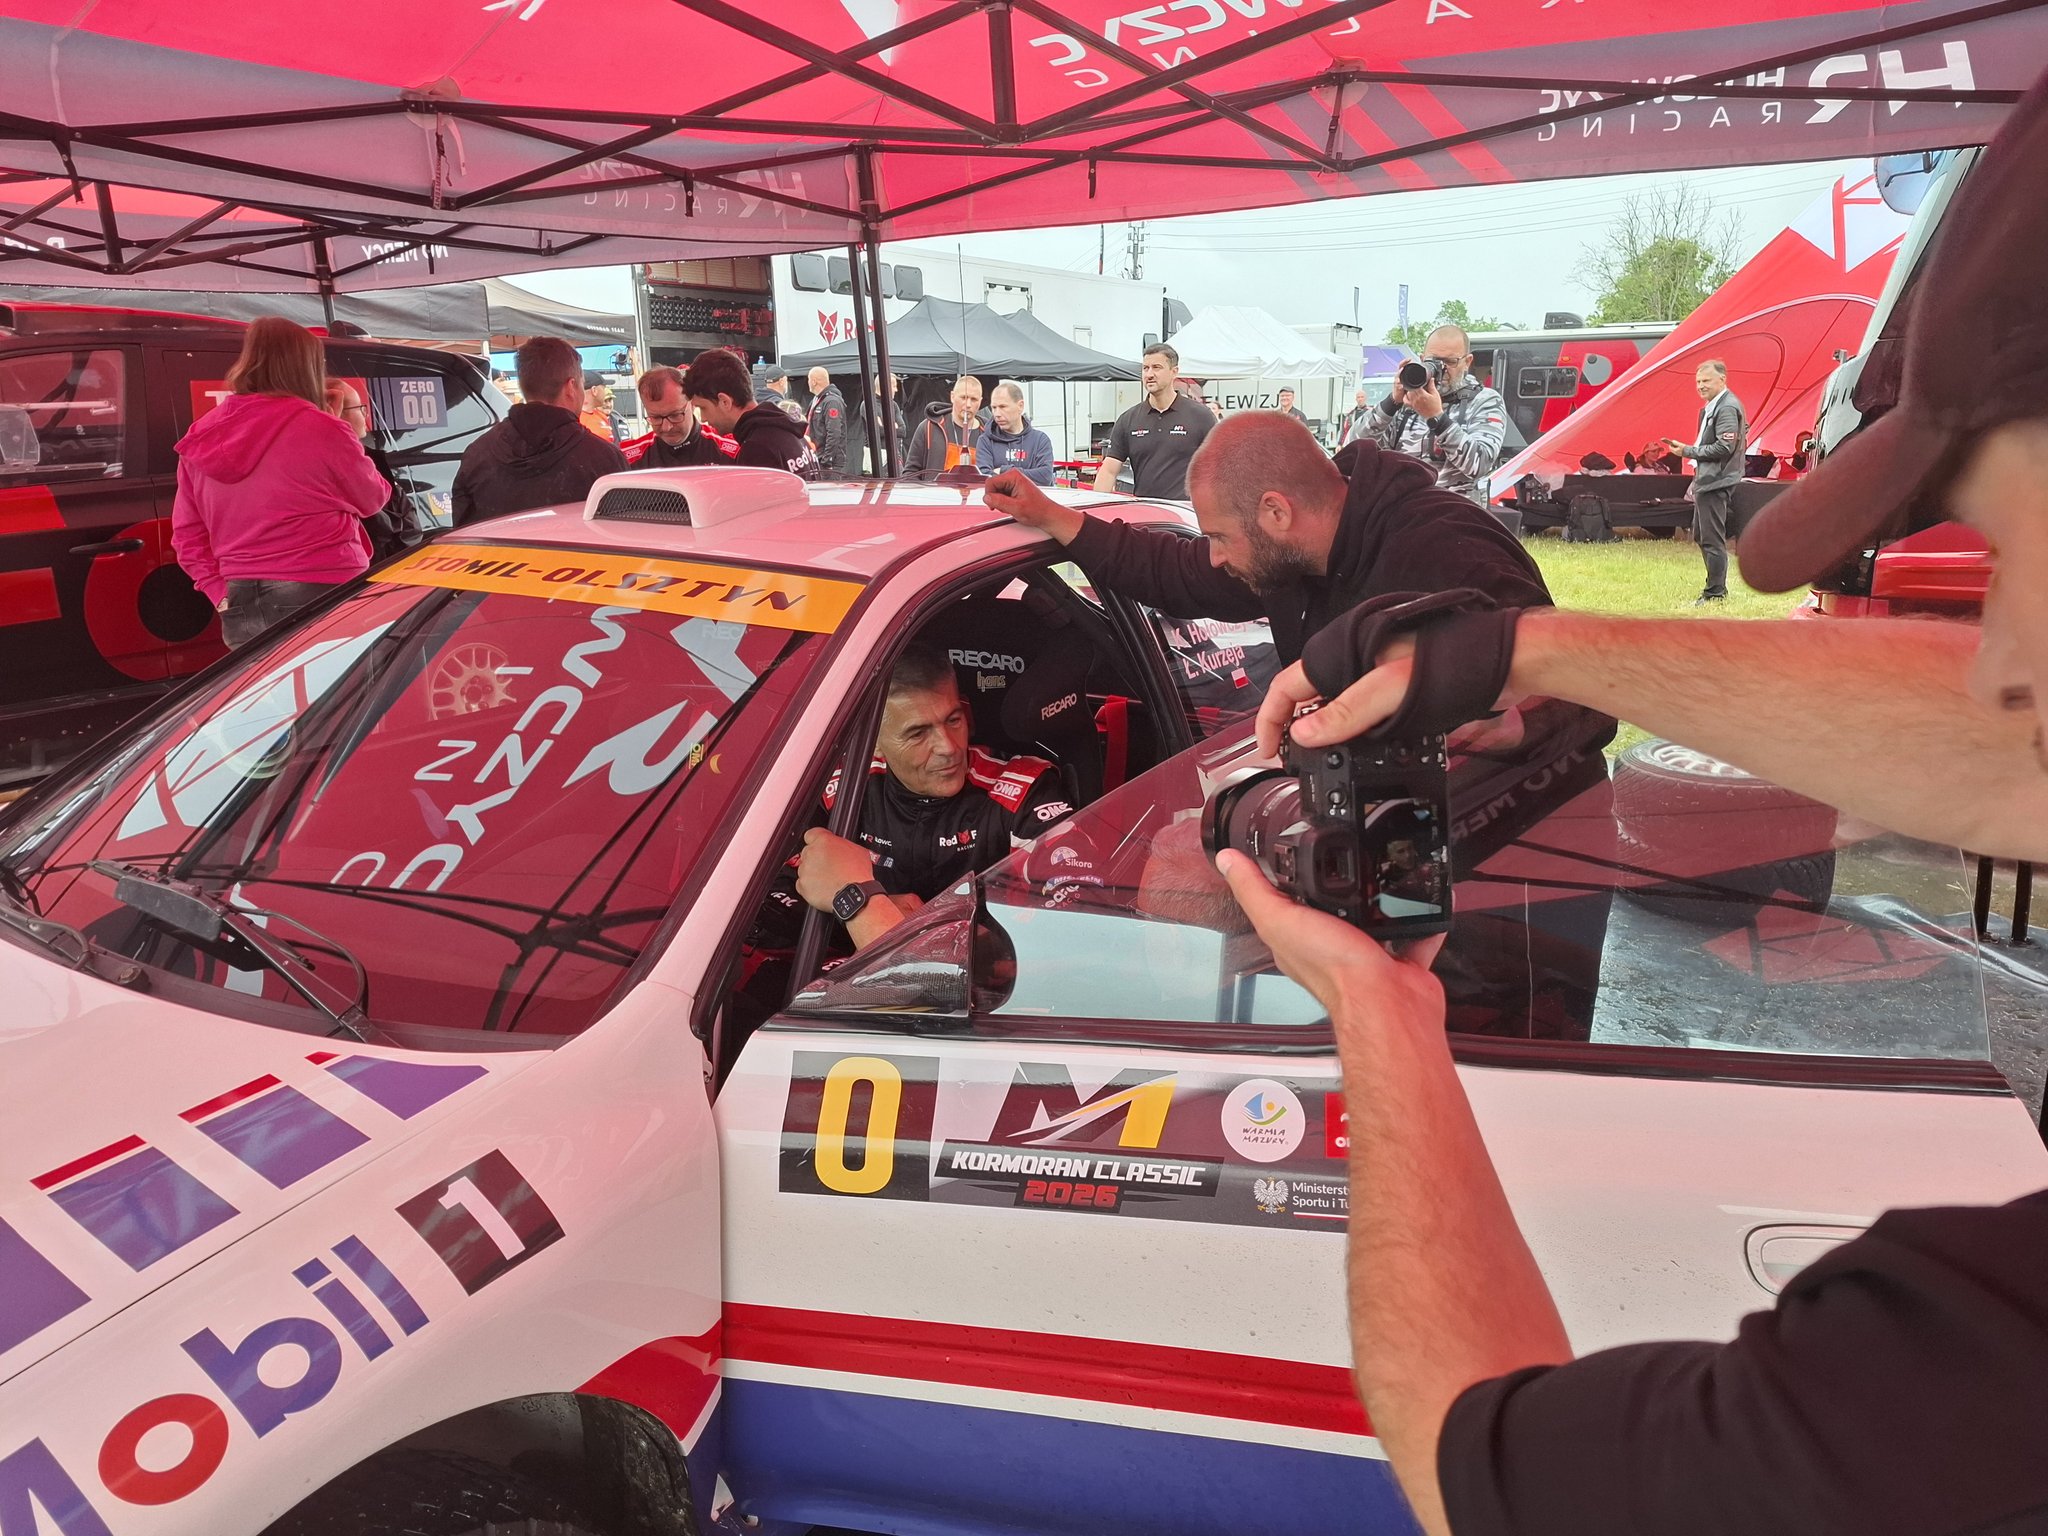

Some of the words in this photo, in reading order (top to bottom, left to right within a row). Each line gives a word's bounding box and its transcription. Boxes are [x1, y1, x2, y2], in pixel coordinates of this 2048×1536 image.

[400, 380, 435, 393] ZERO
[949, 649, 1025, 674] RECARO
[976, 671, 1006, 693] hans
[1041, 692, 1077, 721] RECARO
[993, 782, 1022, 798] OMP
[939, 834, 958, 847] Red
[1065, 858, 1093, 869] Sikora
[1242, 1126, 1286, 1137] WARMIA
[1242, 1136, 1285, 1146] MAZURY
[951, 1151, 1091, 1179] KORMORAN
[1093, 1160, 1206, 1187] CLASSIC
[1023, 1179, 1120, 1208] 2026
[1292, 1182, 1350, 1196] Ministerst
[1292, 1196, 1330, 1209] Sportu
[1332, 1197, 1336, 1209] i
[438, 1177, 529, 1261] 1
